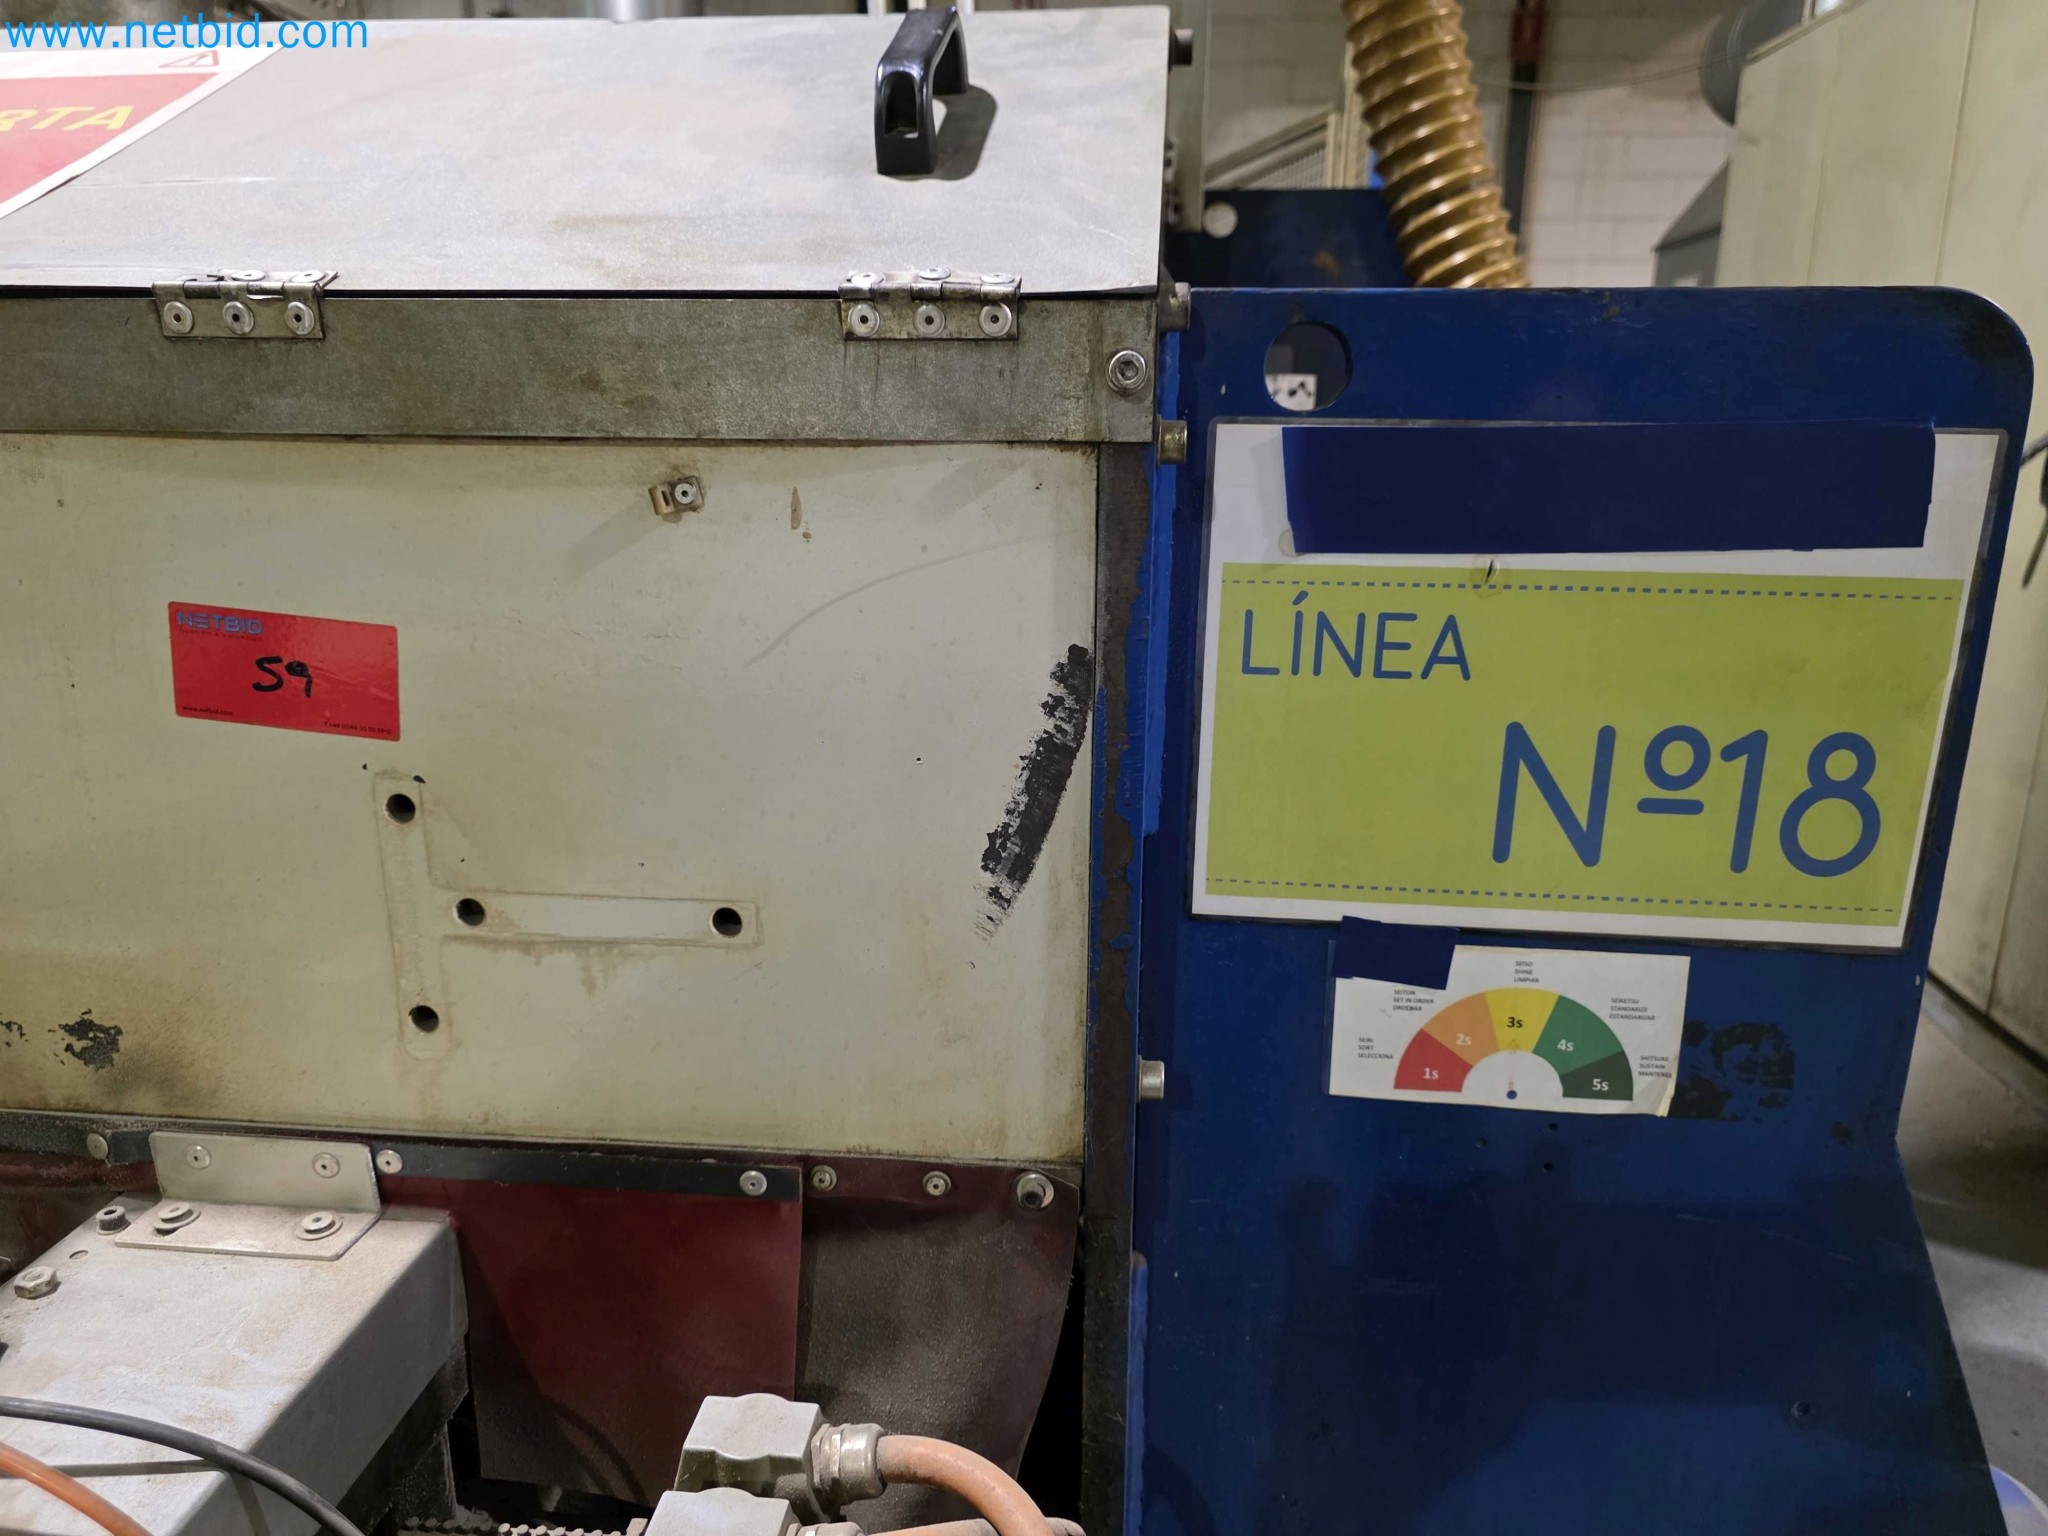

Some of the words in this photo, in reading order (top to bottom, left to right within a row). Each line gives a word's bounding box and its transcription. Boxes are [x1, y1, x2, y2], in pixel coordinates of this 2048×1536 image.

[176, 611, 263, 635] NETBID
[1241, 590, 1471, 682] LÍNEA
[1507, 1016, 1523, 1028] 3s
[1455, 1033, 1472, 1046] 2s
[1557, 1039, 1574, 1052] 4s
[1423, 1067, 1439, 1080] 1s
[1592, 1078, 1609, 1091] 5s
